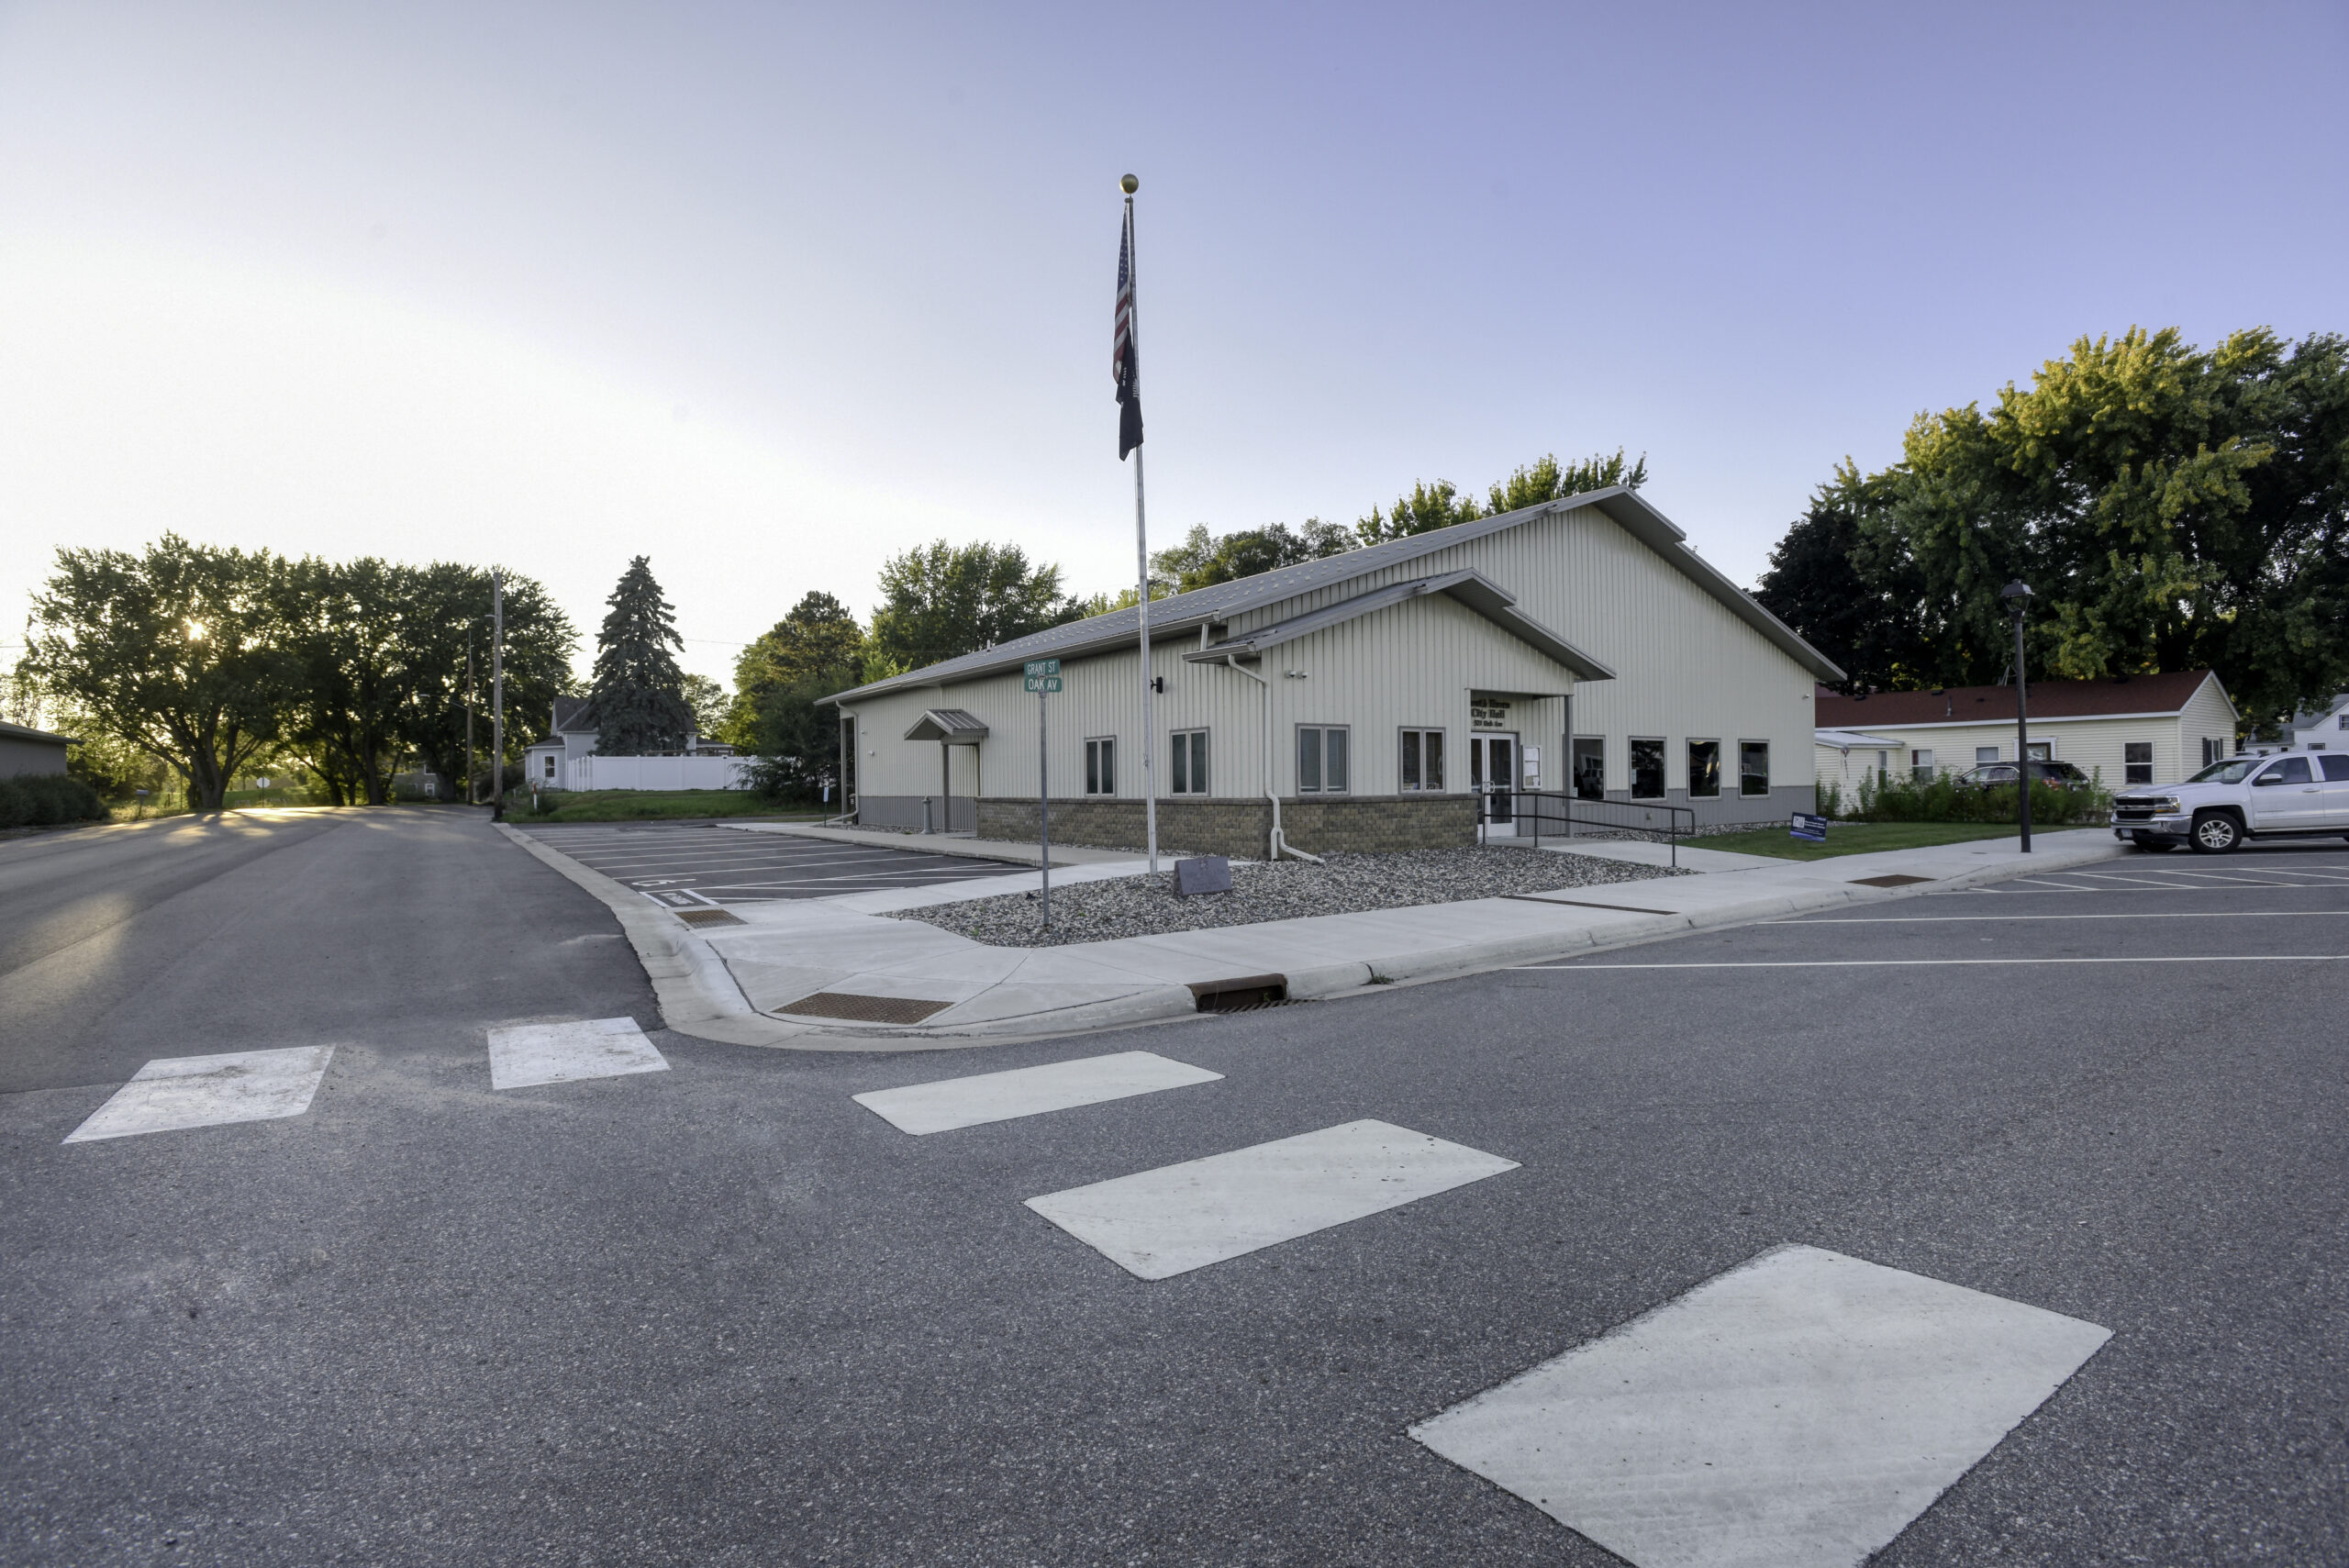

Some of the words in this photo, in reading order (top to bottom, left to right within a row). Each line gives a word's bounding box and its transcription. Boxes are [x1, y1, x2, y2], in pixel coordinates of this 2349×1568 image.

[1027, 662, 1046, 675] GRANT
[1048, 661, 1056, 673] ST
[1028, 678, 1045, 690] OAK
[1047, 679, 1058, 690] AV
